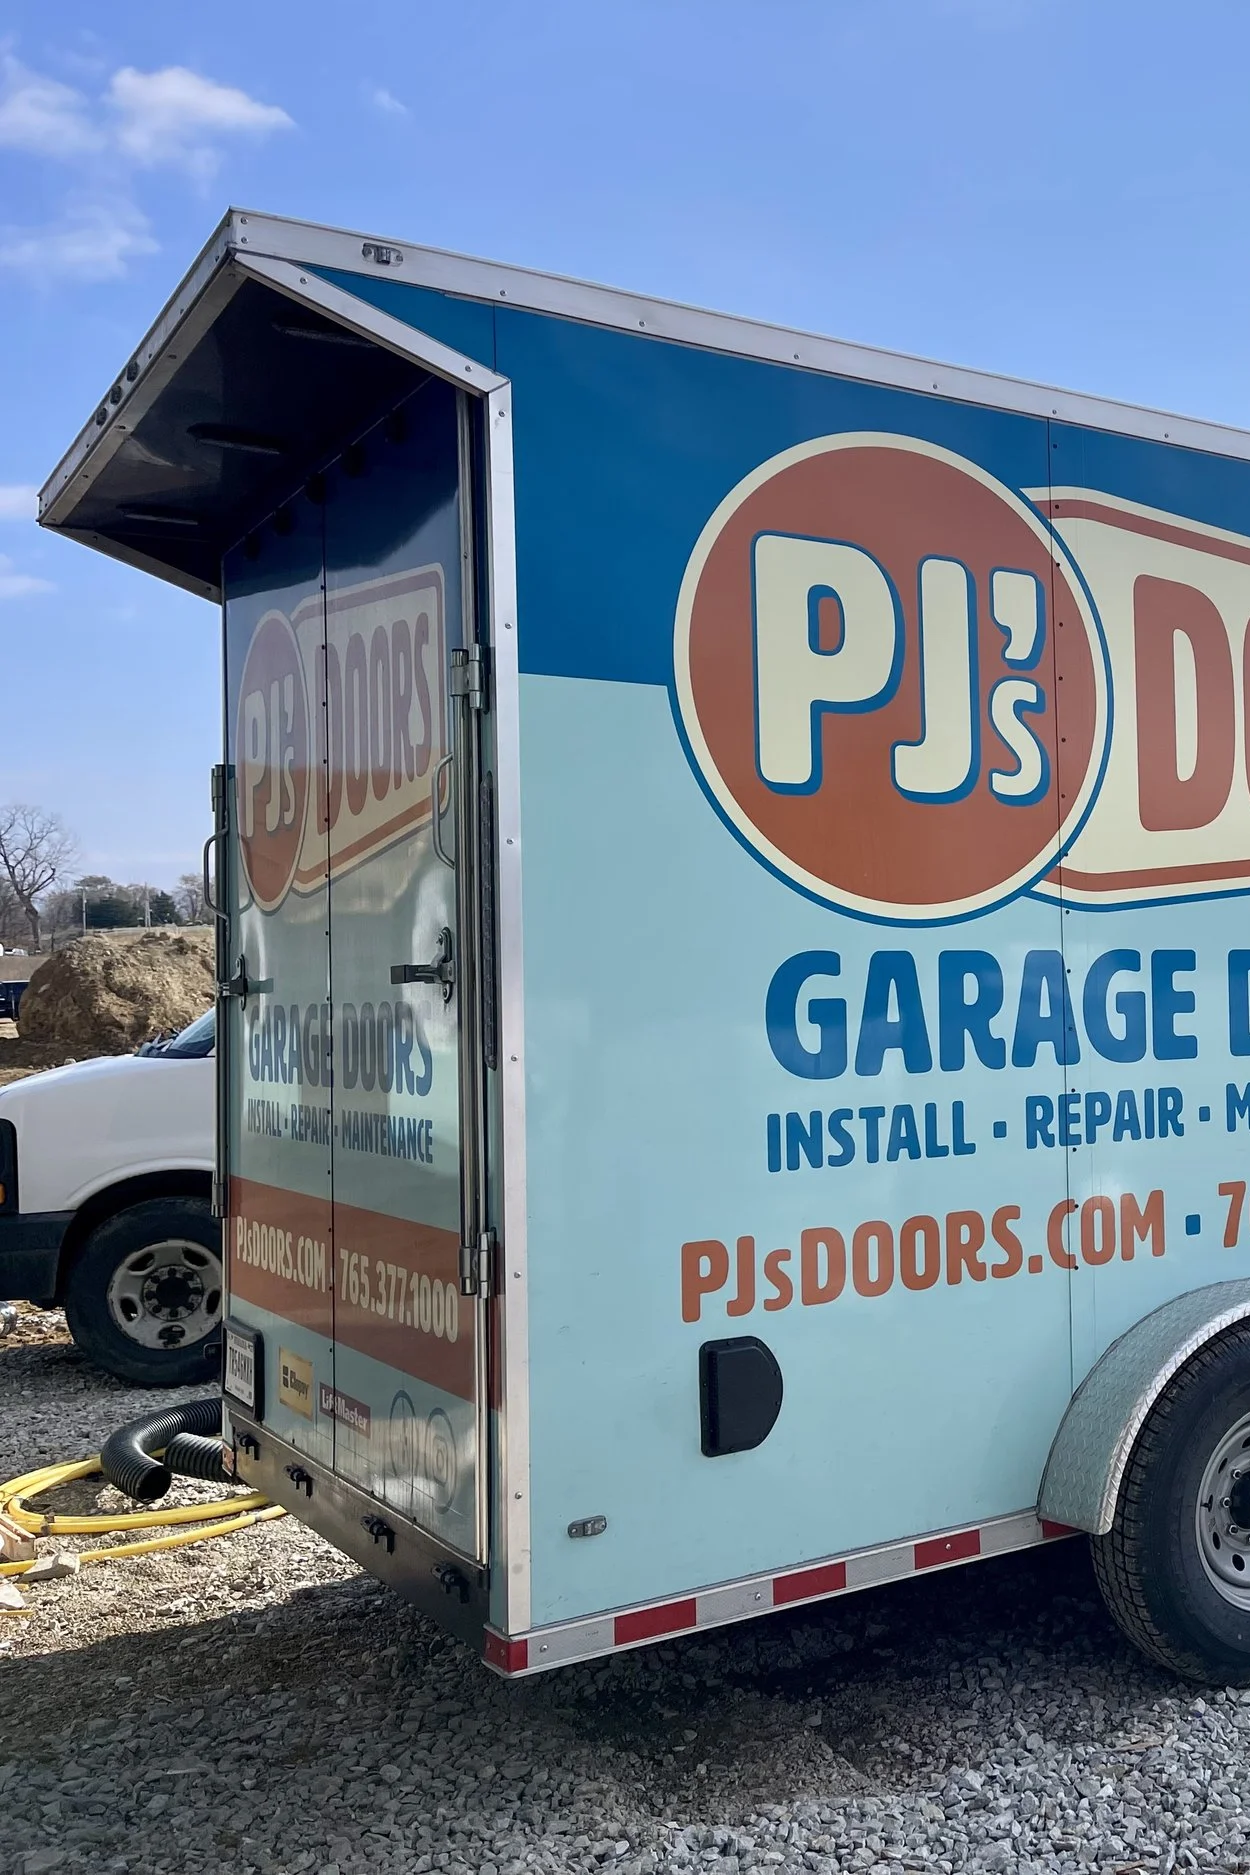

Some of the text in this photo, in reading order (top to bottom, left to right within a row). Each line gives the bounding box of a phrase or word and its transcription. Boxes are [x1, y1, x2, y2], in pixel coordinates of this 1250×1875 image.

[752, 531, 1049, 805] PJ's
[244, 611, 431, 838] PJ's DOORS
[249, 1001, 433, 1097] GARAGE DOORS
[765, 949, 1199, 1080] GARAGE
[247, 1099, 433, 1164] INSTALL REPAIR MAINTENANCE
[767, 1100, 976, 1173] INSTALL
[1026, 1086, 1185, 1150] REPAIR
[340, 1248, 459, 1343] 765.377.1000
[321, 1388, 368, 1431] LiftMaster
